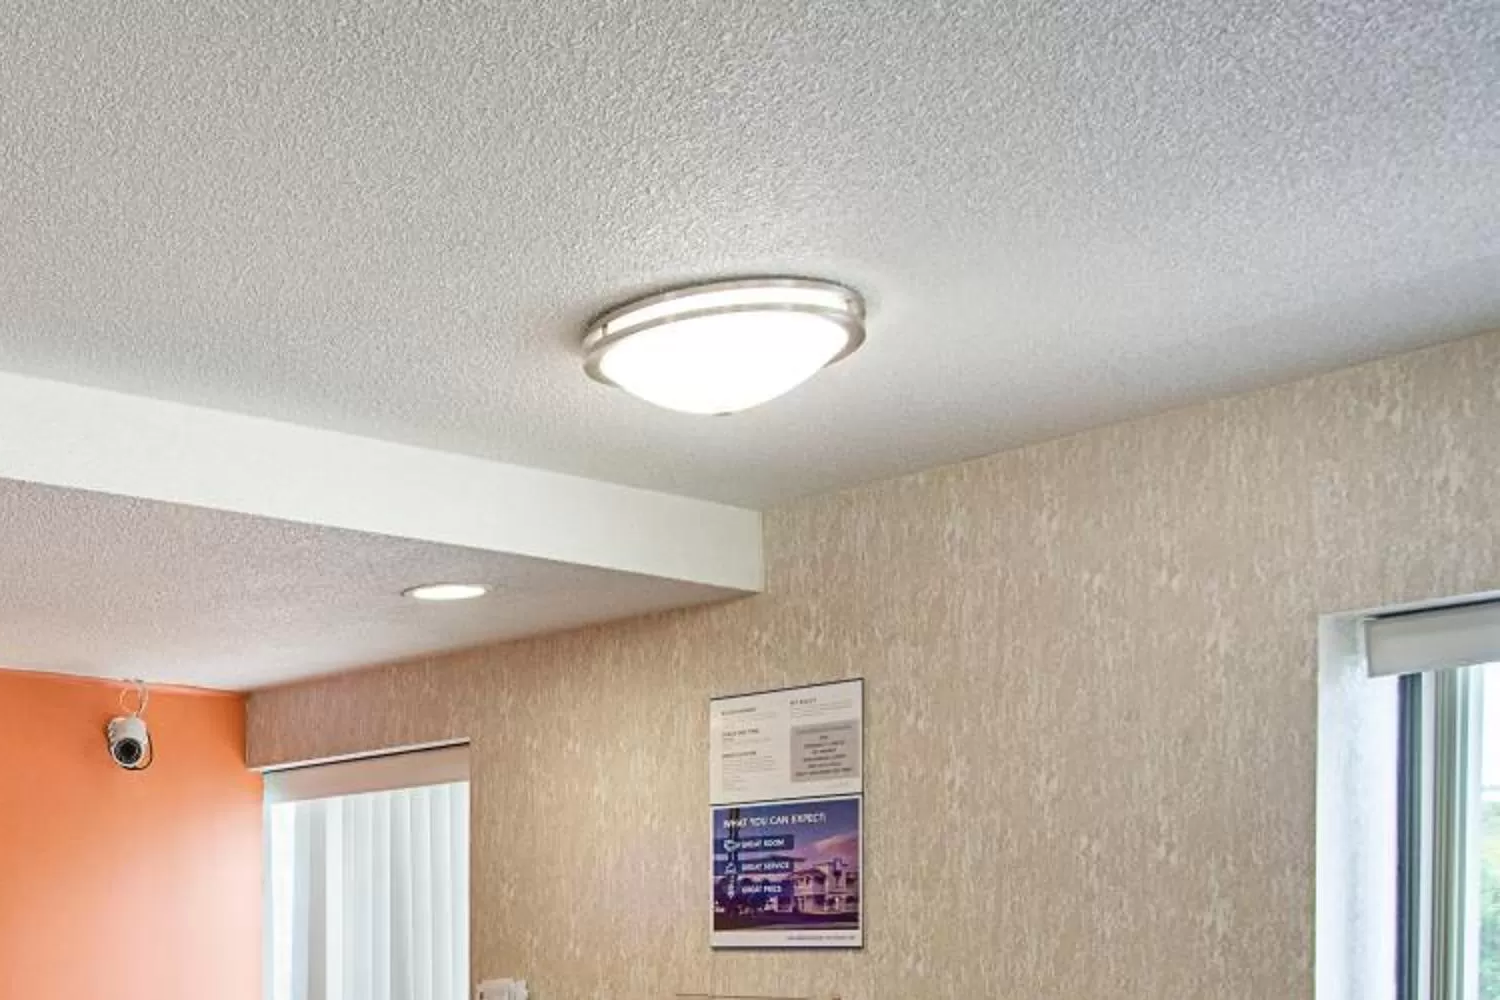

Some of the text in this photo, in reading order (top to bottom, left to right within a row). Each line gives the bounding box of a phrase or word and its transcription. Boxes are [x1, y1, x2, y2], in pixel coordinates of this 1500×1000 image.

[723, 817, 747, 829] WHAT
[749, 816, 769, 827] YOU
[769, 815, 790, 825] CAN
[763, 838, 785, 848] ROOM
